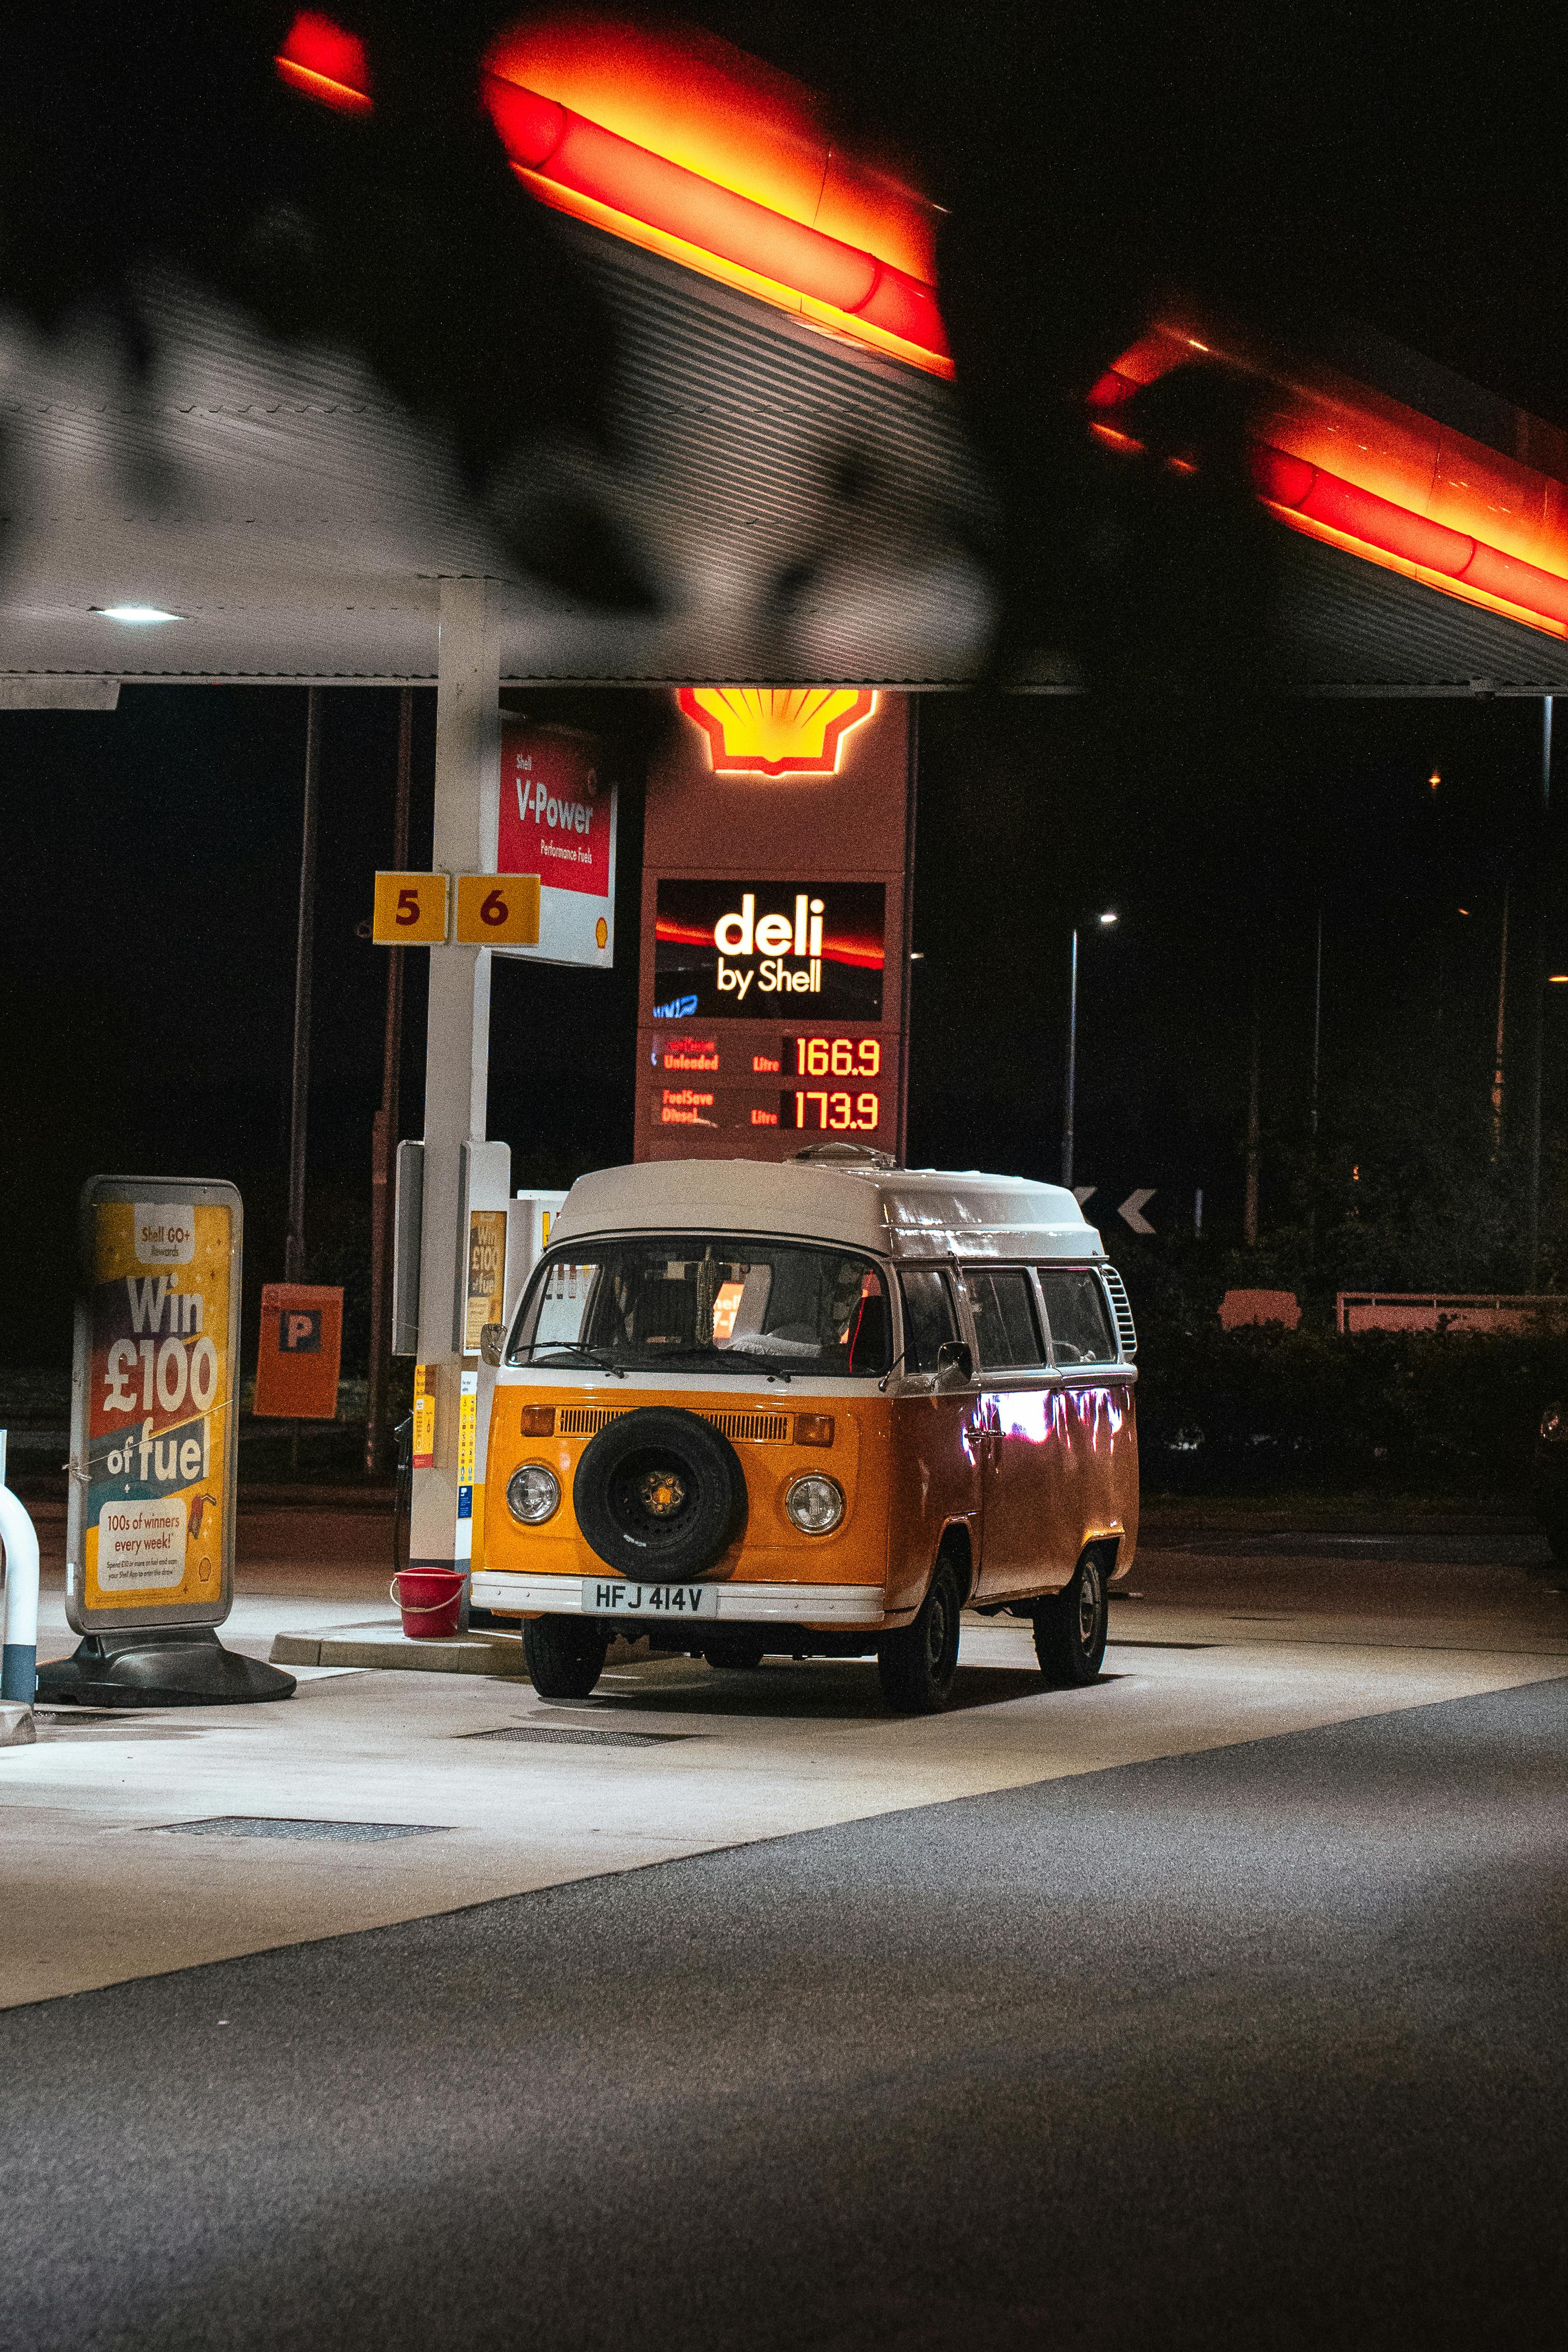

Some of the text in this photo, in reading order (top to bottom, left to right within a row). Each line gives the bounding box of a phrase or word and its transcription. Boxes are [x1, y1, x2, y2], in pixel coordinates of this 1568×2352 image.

[516, 753, 532, 771] Shell
[516, 778, 593, 835] V-Power
[541, 838, 592, 864] Performance Fuels
[395, 889, 420, 926] 5
[480, 890, 509, 926] 6
[715, 894, 824, 956] deli
[718, 957, 821, 1000] by Shell
[663, 1054, 719, 1070] Unleaded
[752, 1056, 780, 1072] Litre
[797, 1038, 880, 1076] 166.9
[662, 1089, 714, 1106] FuelSave
[795, 1091, 879, 1129] 173.9
[662, 1107, 698, 1123] Diesel
[751, 1109, 778, 1125] Litre
[141, 1226, 190, 1243] Shell GO+
[126, 1273, 204, 1332] Win
[288, 1315, 312, 1347] P
[103, 1337, 217, 1412] £100
[107, 1417, 210, 1480] of fuel
[108, 1513, 180, 1531] 100s of winners
[114, 1541, 141, 1555] every
[119, 1571, 129, 1579] Shell
[596, 1585, 702, 1611] HFJ 414V
